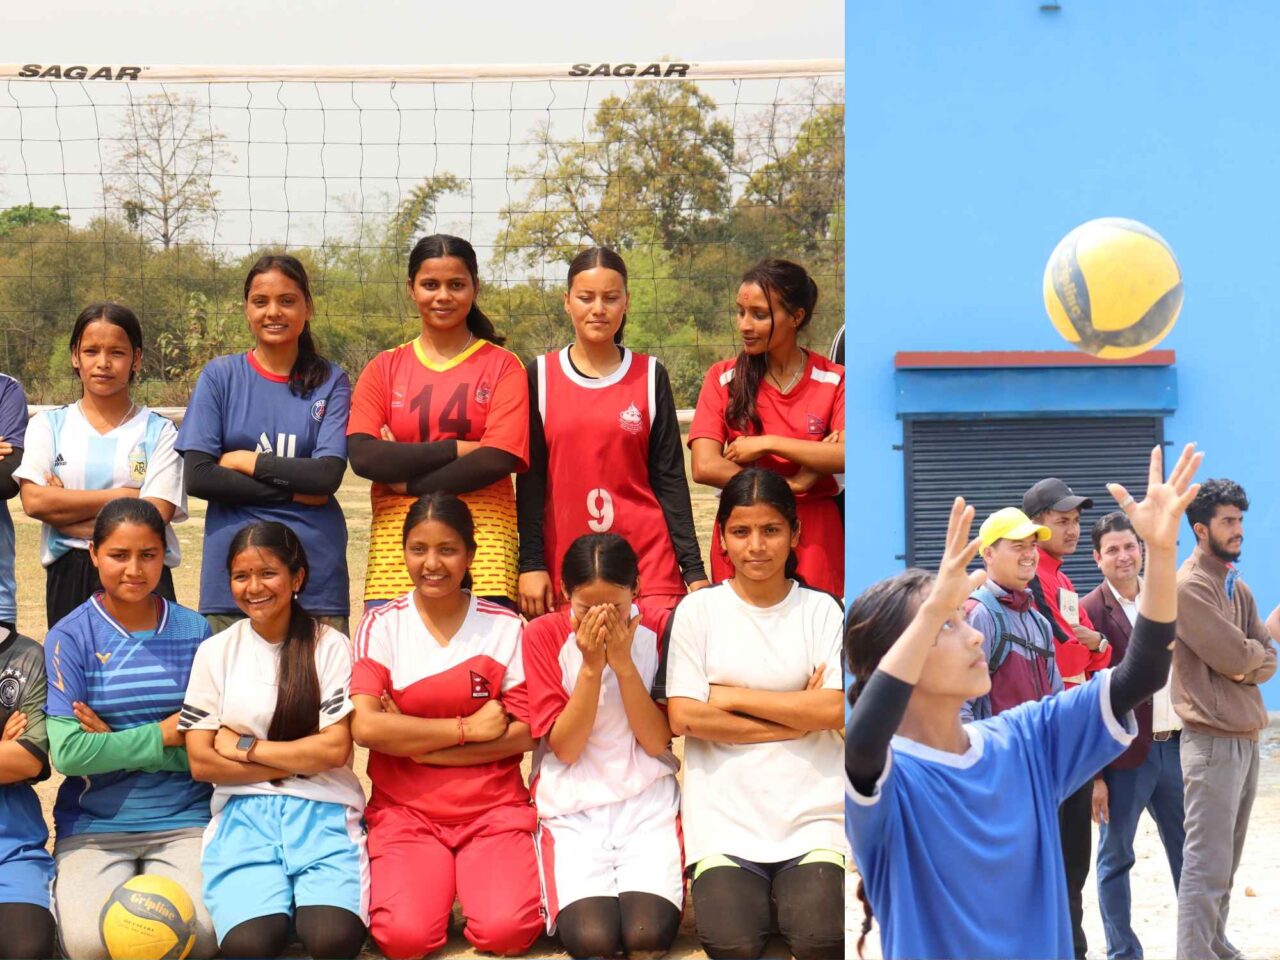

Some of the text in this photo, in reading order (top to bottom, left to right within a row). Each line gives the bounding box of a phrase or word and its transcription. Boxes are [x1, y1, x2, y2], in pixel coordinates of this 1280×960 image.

[18, 64, 142, 80] SAGAR
[568, 63, 690, 77] SAGAR
[409, 383, 472, 442] 14
[586, 488, 615, 533] 9
